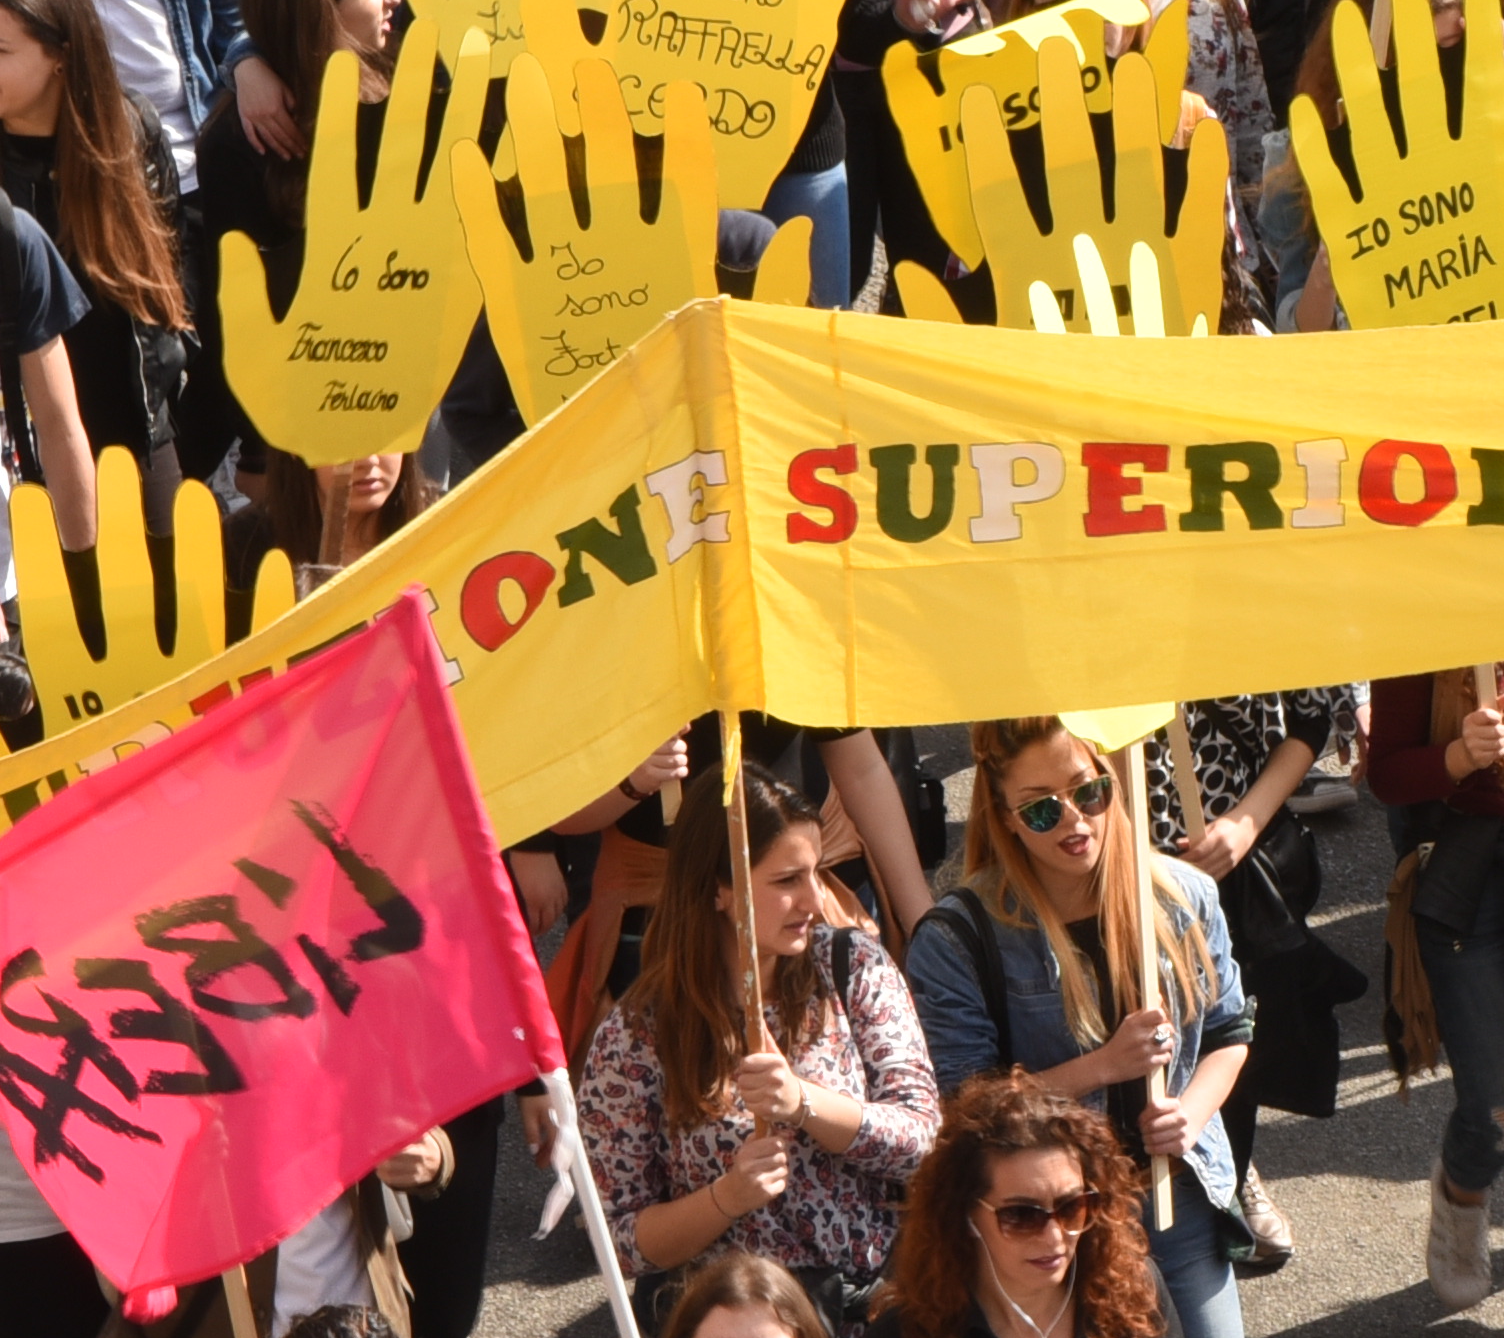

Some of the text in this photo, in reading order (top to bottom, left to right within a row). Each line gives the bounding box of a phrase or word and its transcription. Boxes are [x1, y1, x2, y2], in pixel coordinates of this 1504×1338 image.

[1346, 182, 1476, 261] IO SONO
[549, 242, 606, 282] Io
[1383, 233, 1497, 309] MARIA
[555, 283, 649, 318] sono
